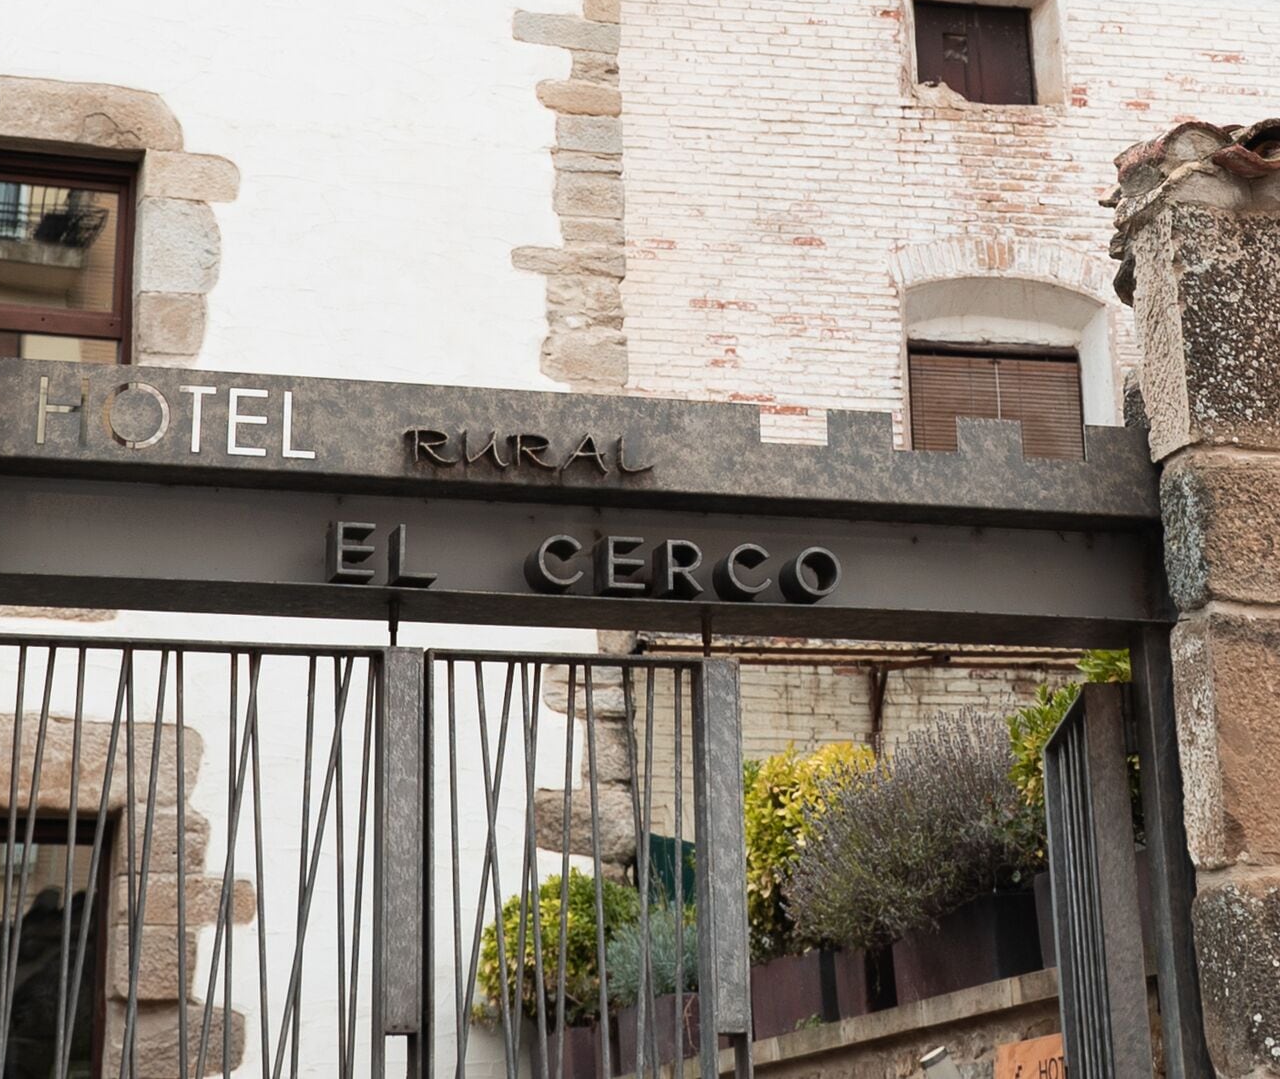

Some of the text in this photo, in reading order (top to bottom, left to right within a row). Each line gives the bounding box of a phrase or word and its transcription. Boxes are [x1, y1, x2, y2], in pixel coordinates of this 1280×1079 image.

[36, 376, 655, 476] HOTEL RURAL
[329, 520, 842, 604] EL CERCO
